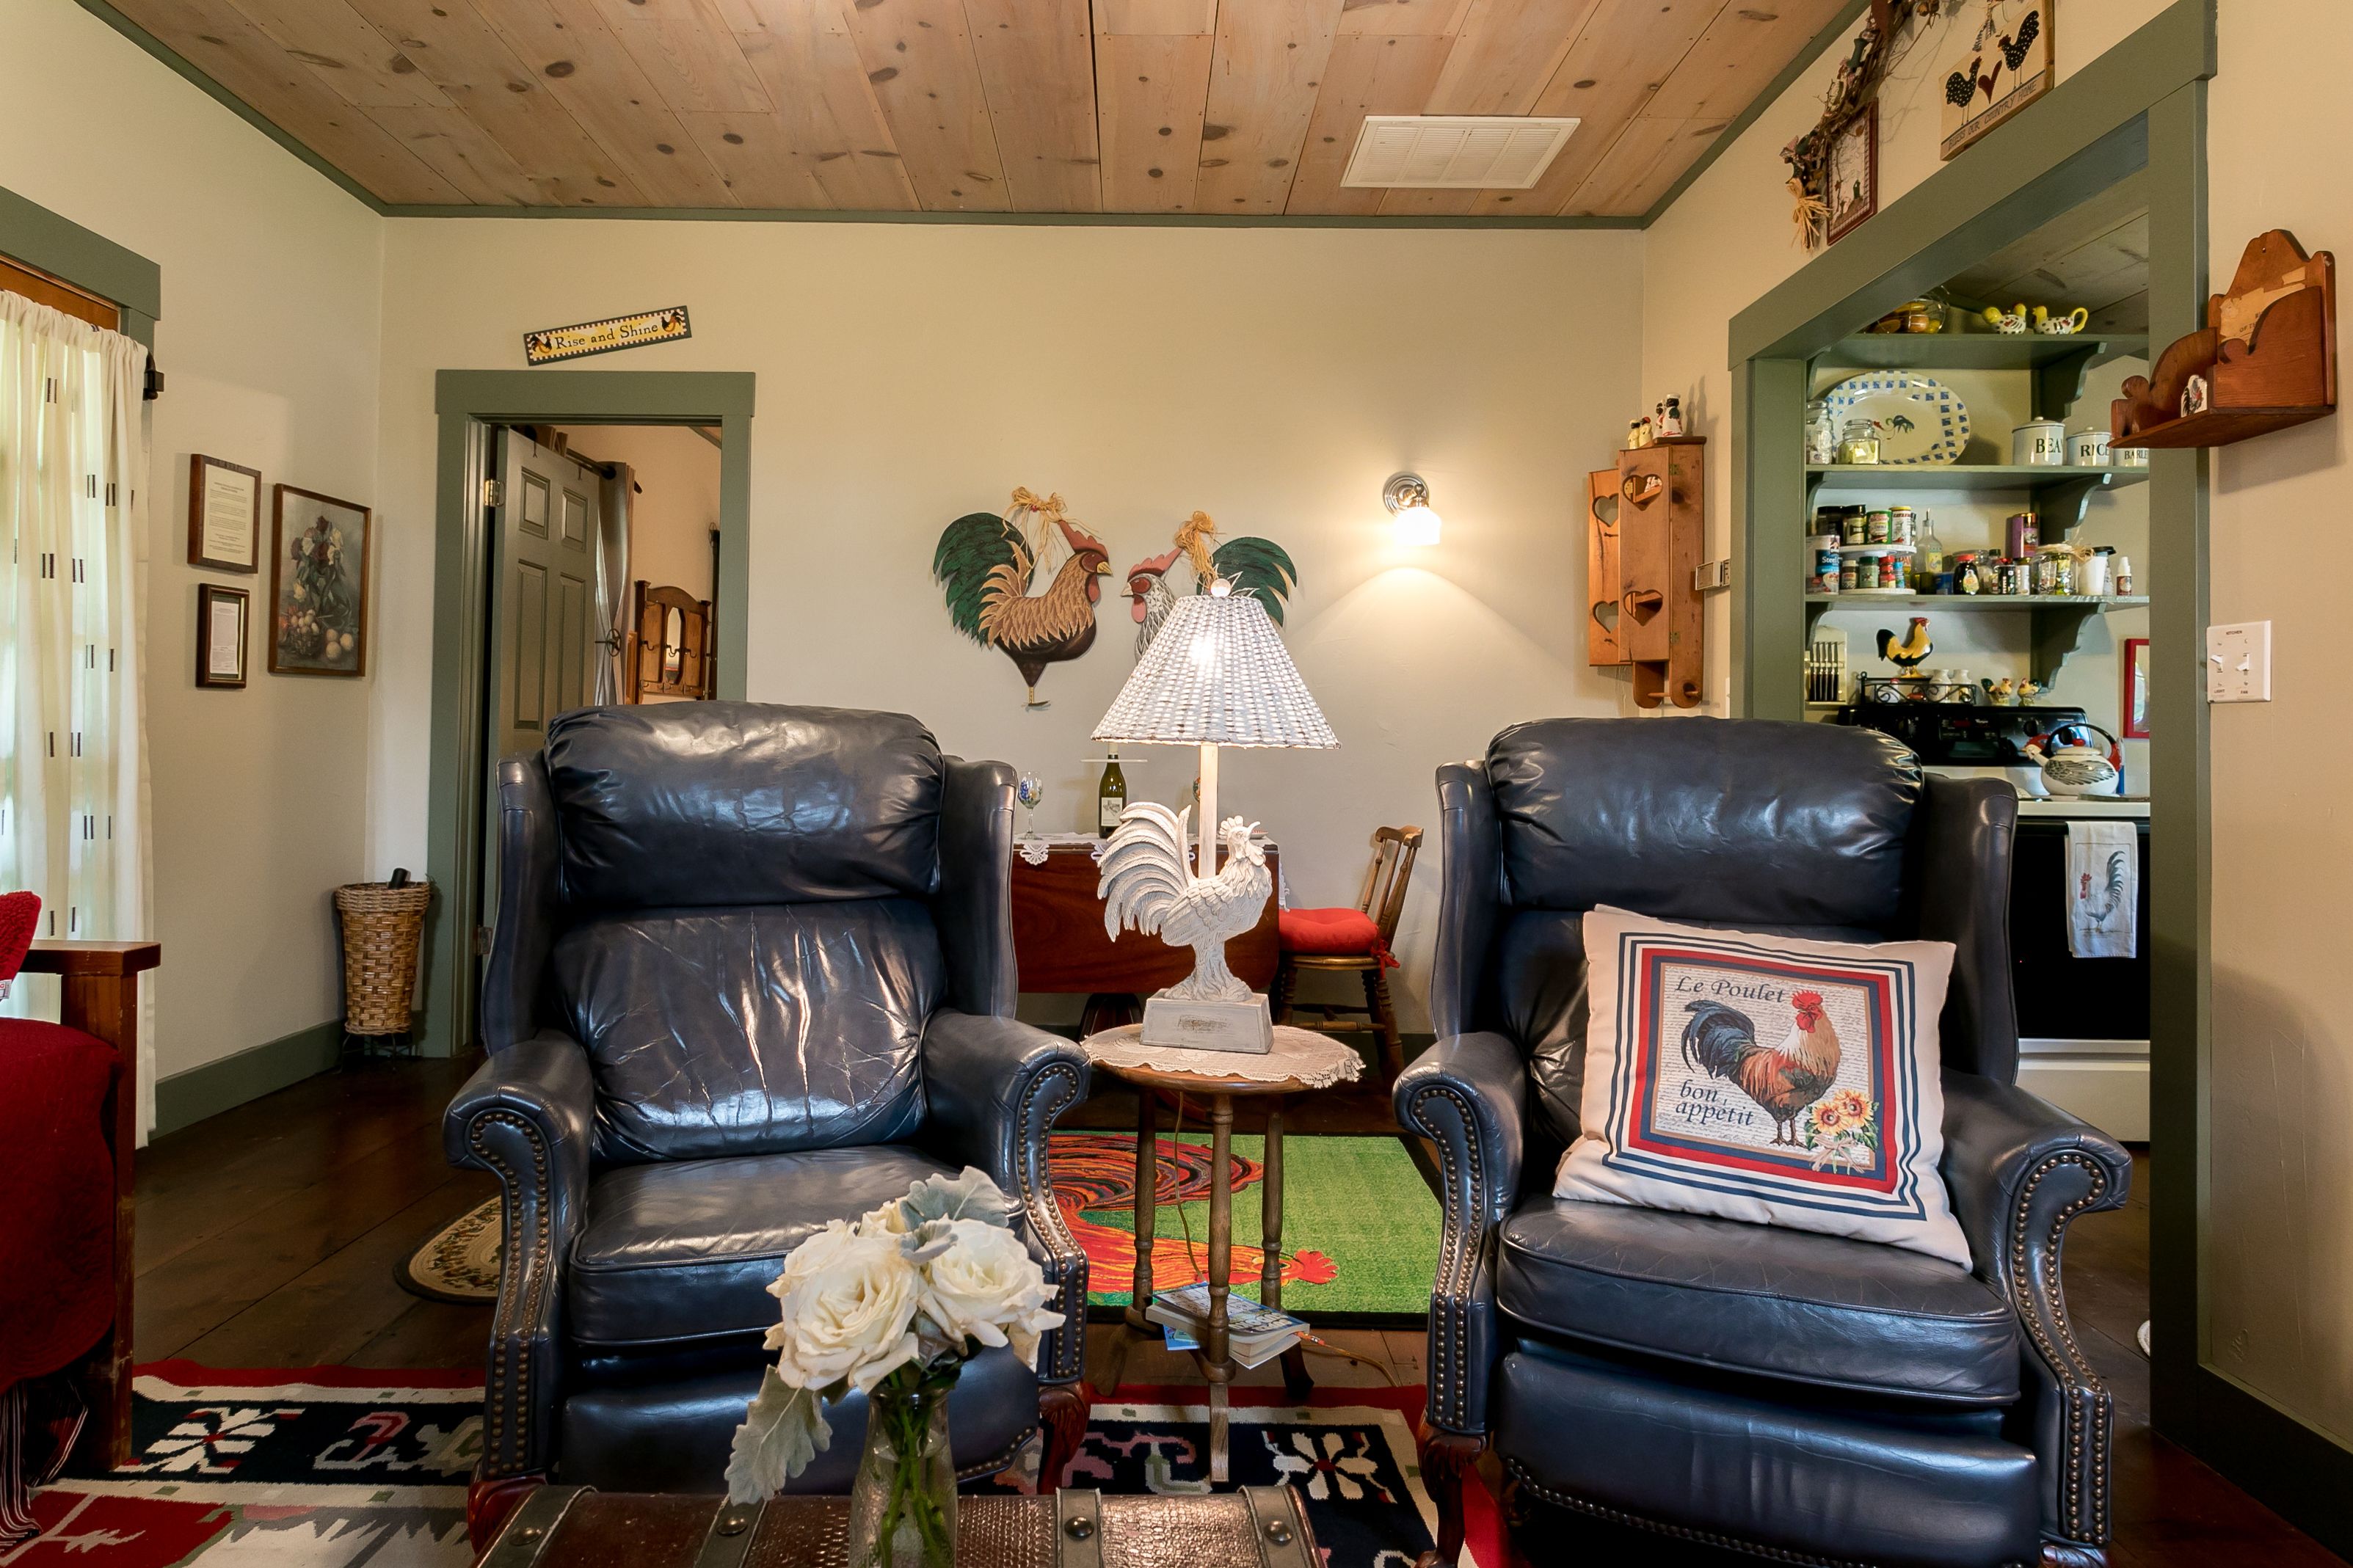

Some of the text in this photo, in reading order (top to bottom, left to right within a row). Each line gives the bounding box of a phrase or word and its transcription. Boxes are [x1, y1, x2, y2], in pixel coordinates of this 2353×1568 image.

[1984, 96, 2015, 125] COUNTRY
[2017, 80, 2037, 102] HOME
[555, 323, 658, 350] Rise and Shine
[2036, 438, 2063, 454] BEA
[1674, 976, 1785, 1003] Le Poulet
[1680, 1079, 1718, 1102] bon
[1675, 1098, 1753, 1126] appétit
